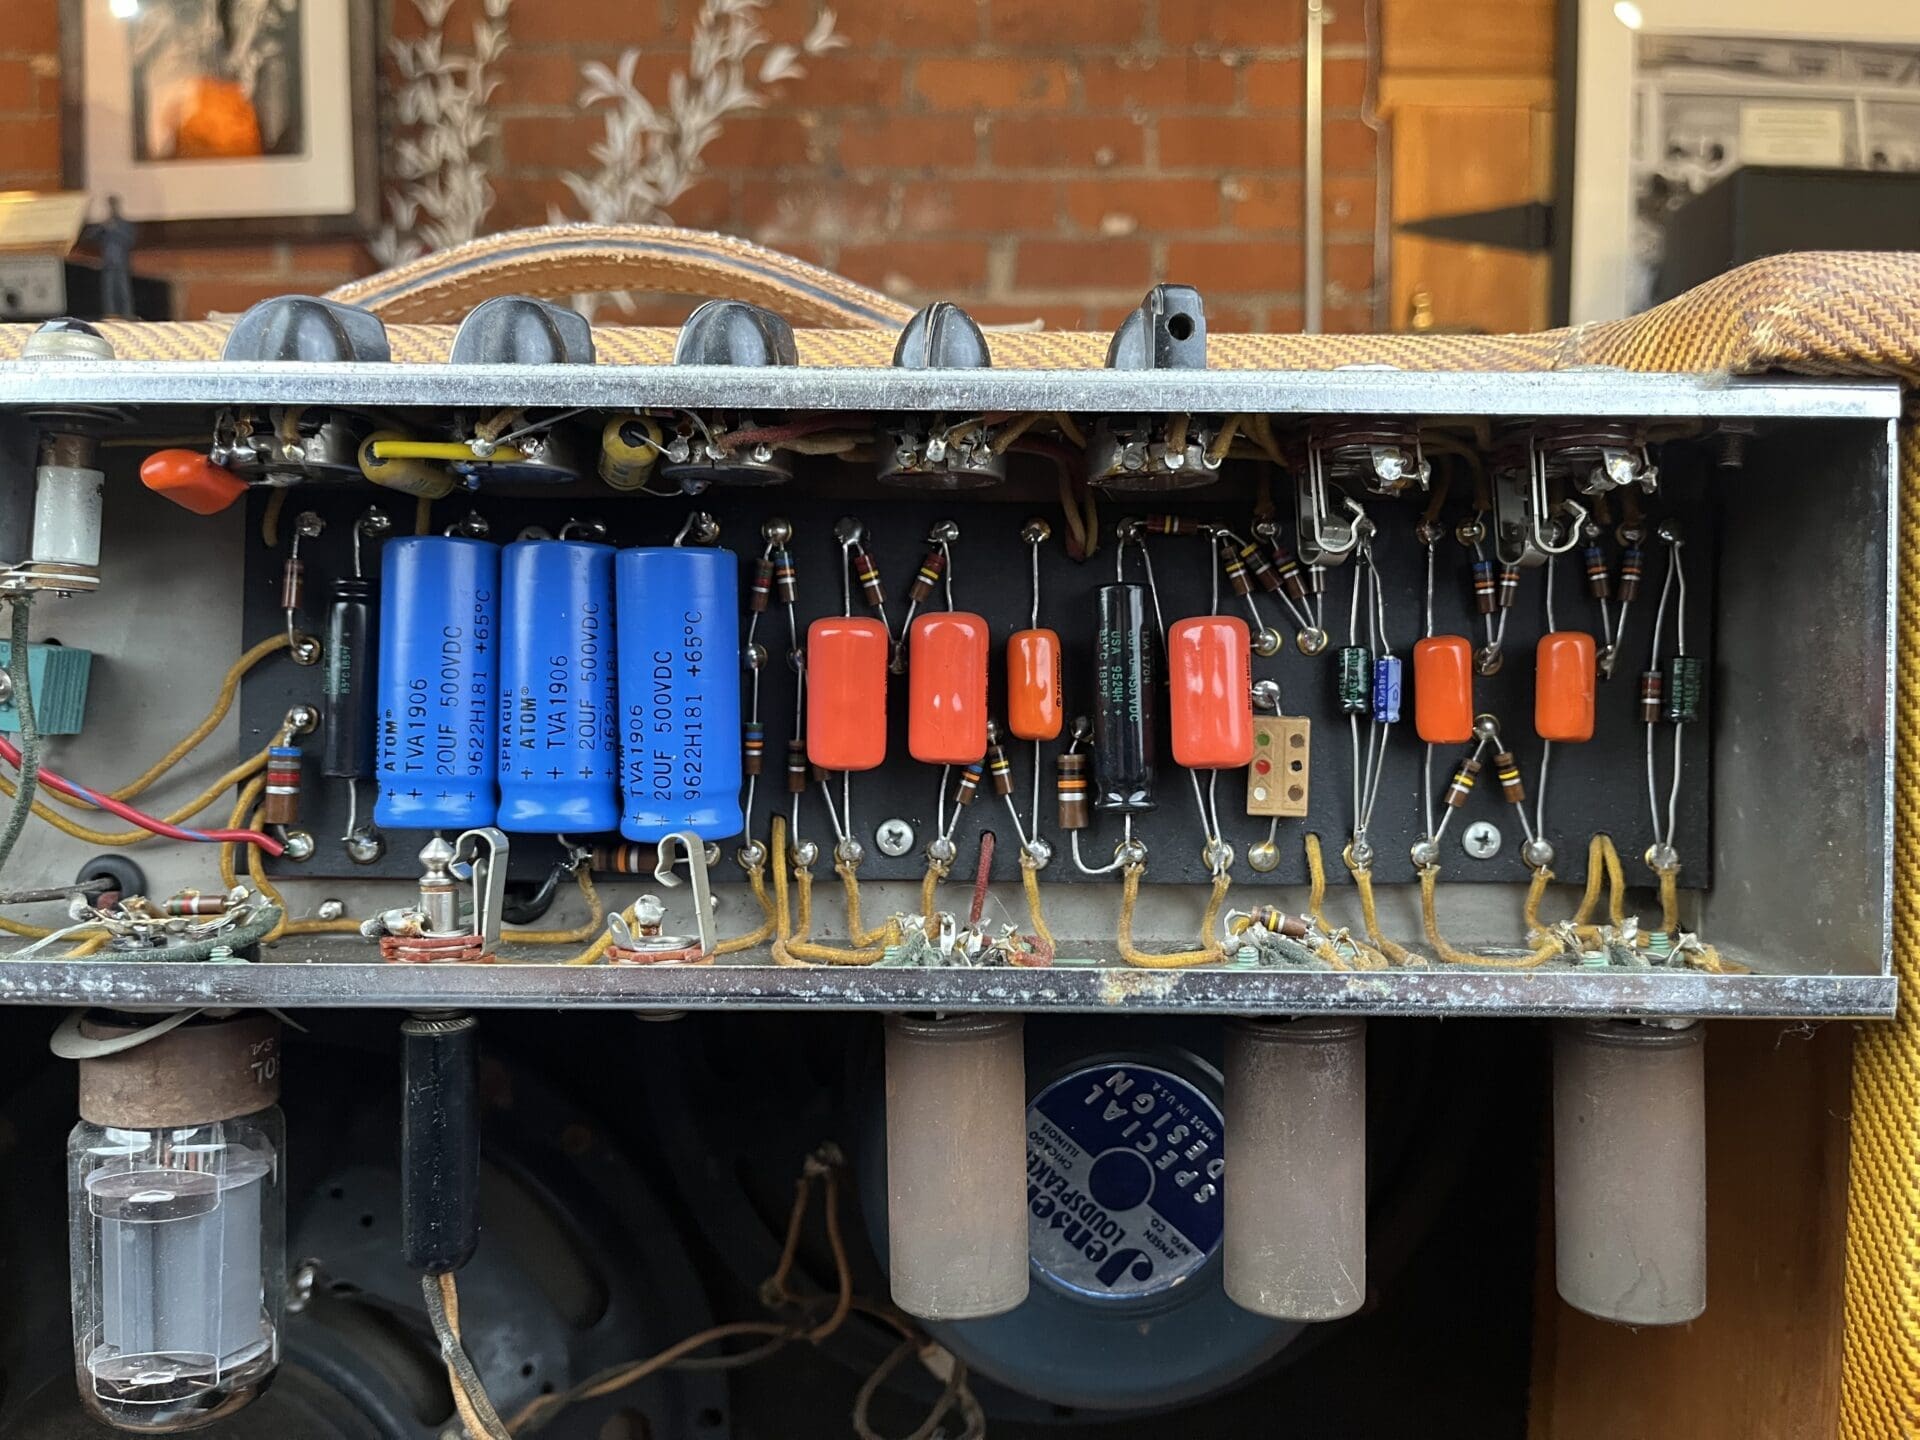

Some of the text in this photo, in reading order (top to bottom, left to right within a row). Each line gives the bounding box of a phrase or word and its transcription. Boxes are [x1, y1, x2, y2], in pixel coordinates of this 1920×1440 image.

[436, 626, 462, 776] 20UF 500VDC
[579, 602, 599, 750] 20UF 500VDC
[1111, 630, 1124, 703] USA 9524H
[467, 672, 488, 776] 9622H181
[501, 688, 513, 772] SPRAGUE
[653, 651, 673, 800] 20UF 500VDC
[684, 695, 703, 800] 9622H181
[1029, 1131, 1073, 1170] CHICAGO
[1040, 1122, 1081, 1158] ILLINOIS
[1085, 1084, 1216, 1203] SPECIAL
[1106, 1070, 1224, 1179] DESIGN
[1176, 1103, 1190, 1117] IN
[1190, 1115, 1217, 1141] MADE
[1027, 1150, 1126, 1247] LOUDSPEAKE
[1143, 1229, 1178, 1260] JENSEN
